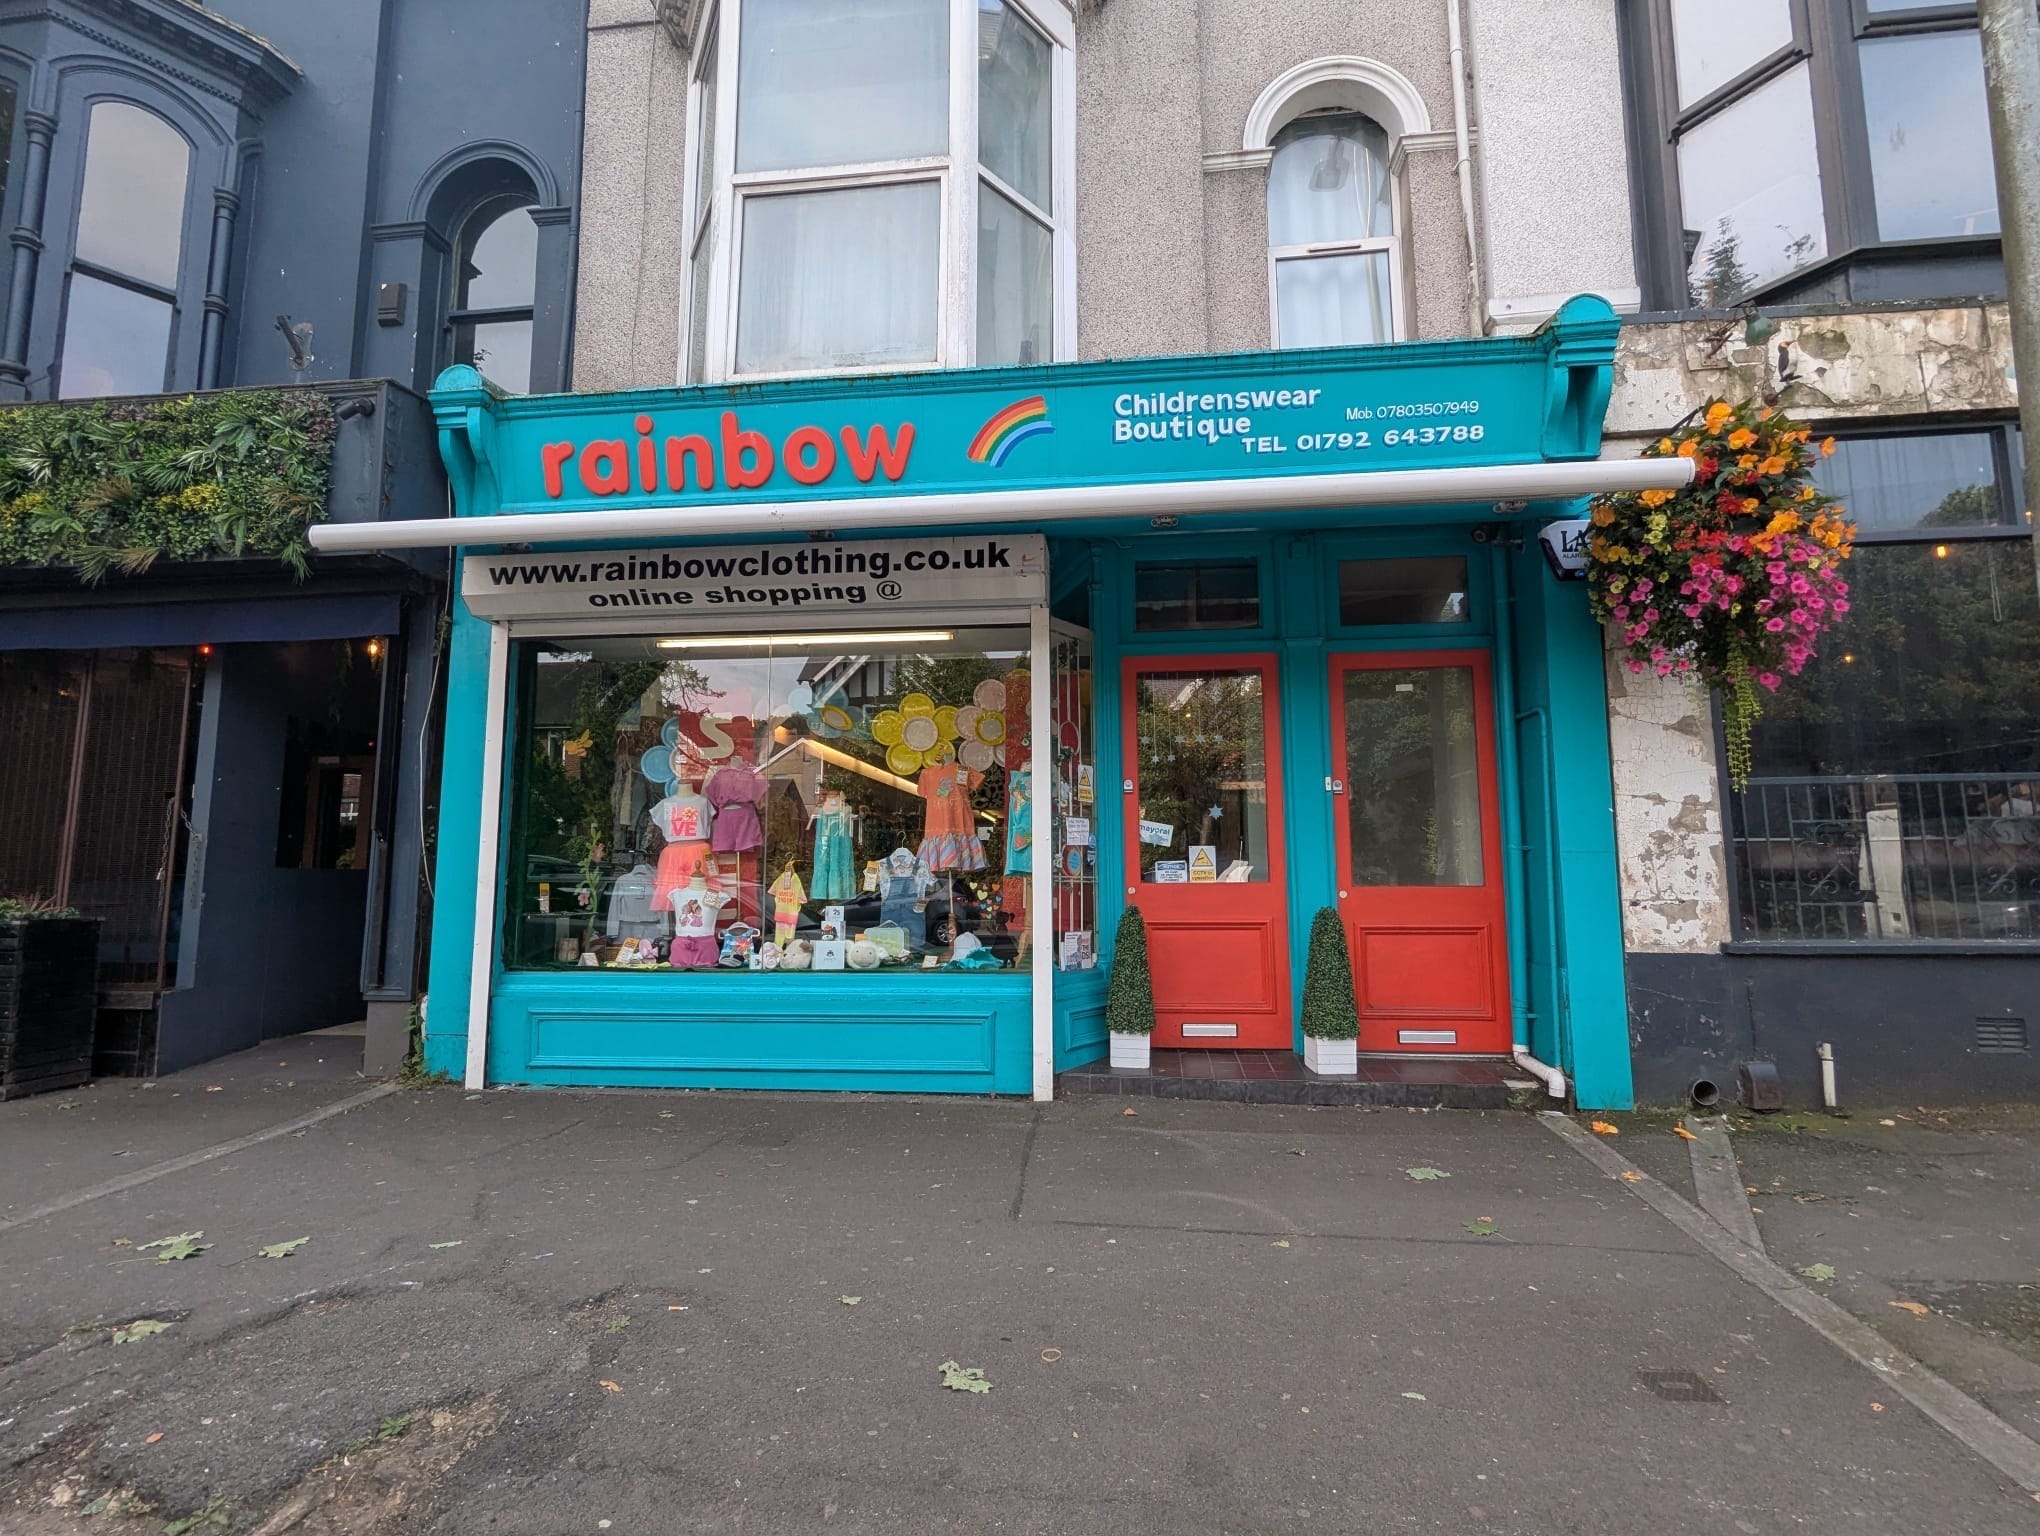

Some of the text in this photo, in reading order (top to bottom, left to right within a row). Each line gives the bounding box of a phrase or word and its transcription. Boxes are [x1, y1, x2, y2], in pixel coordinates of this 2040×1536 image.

[1114, 388, 1321, 416] Childrenswear
[1376, 400, 1479, 419] 07803507949
[1113, 415, 1251, 444] Boutique
[1241, 425, 1485, 454] TEL 01792 643788
[541, 410, 916, 498] rainbow
[489, 541, 1010, 585] www.rainbowclothing.co.uk
[588, 580, 902, 608] online shopping @
